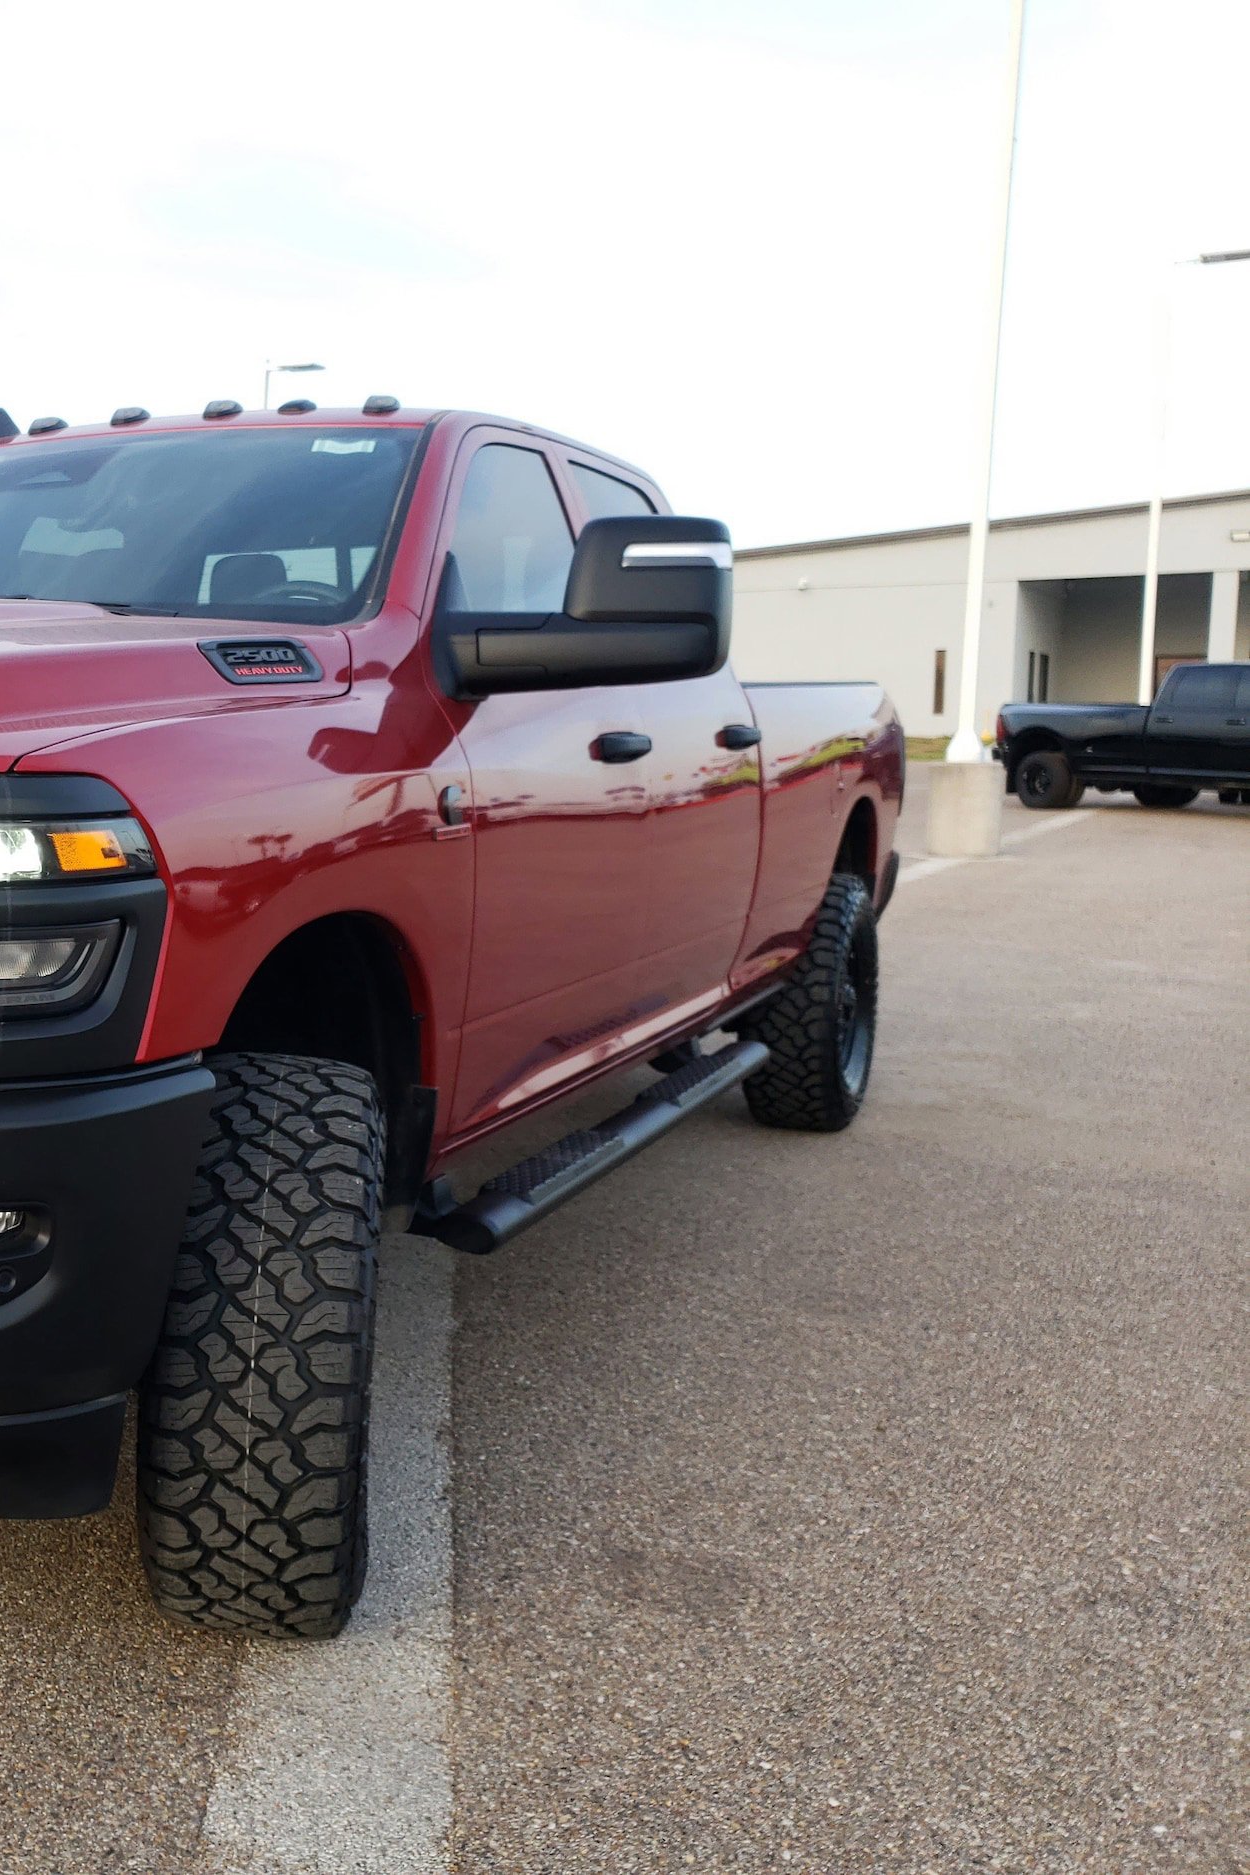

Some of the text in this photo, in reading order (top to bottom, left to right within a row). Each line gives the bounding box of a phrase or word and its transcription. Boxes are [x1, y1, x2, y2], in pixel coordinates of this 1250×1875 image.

[227, 649, 296, 662] 2500
[235, 666, 303, 675] HEAVY DUTY
